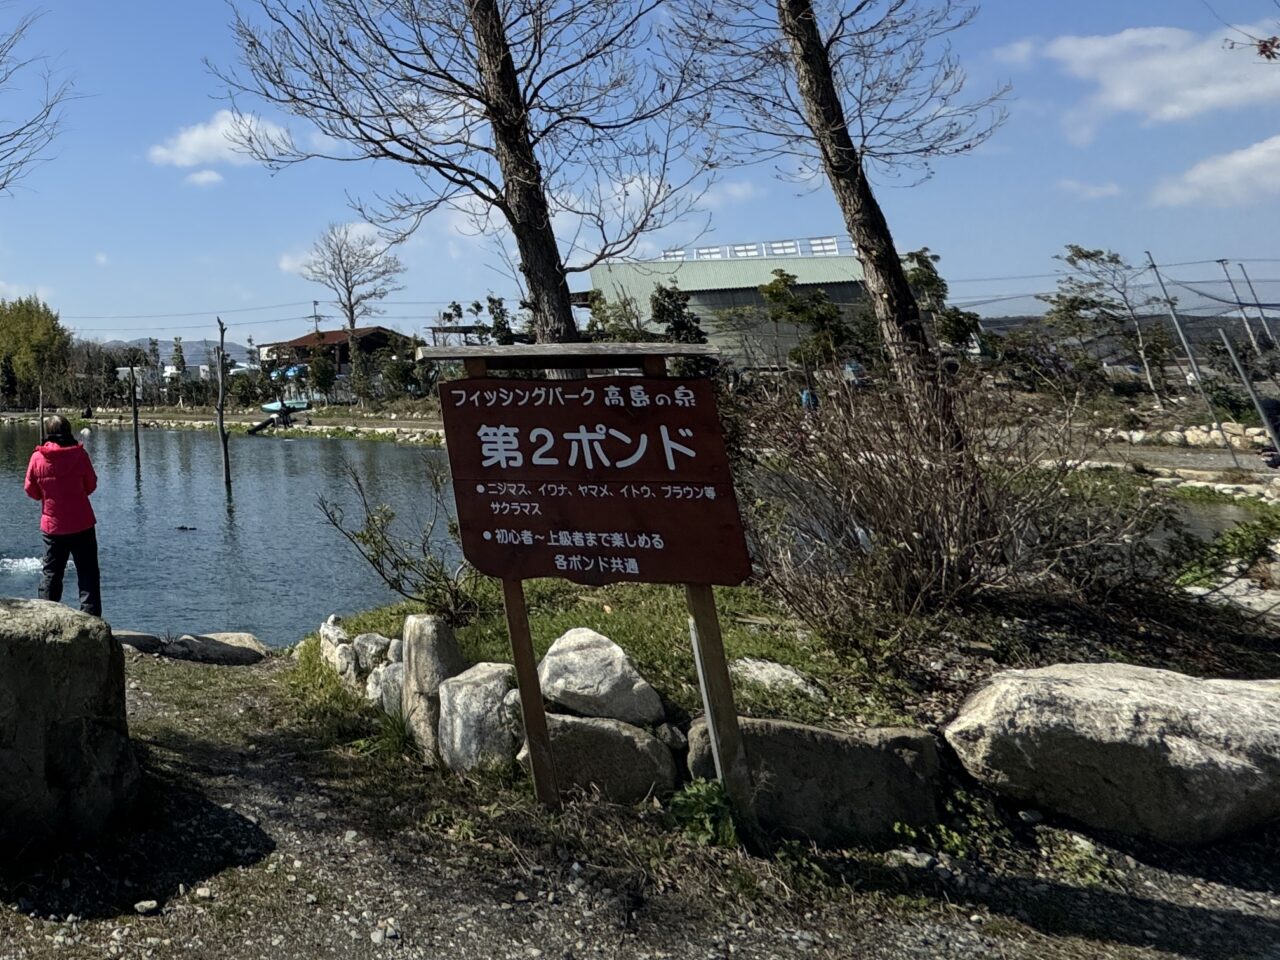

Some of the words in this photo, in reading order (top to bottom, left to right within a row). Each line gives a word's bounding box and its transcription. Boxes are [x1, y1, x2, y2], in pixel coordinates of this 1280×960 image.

[451, 387, 595, 407] フィッシングパーク
[477, 423, 696, 470] 第2ポンド
[490, 502, 542, 515] サクラマス
